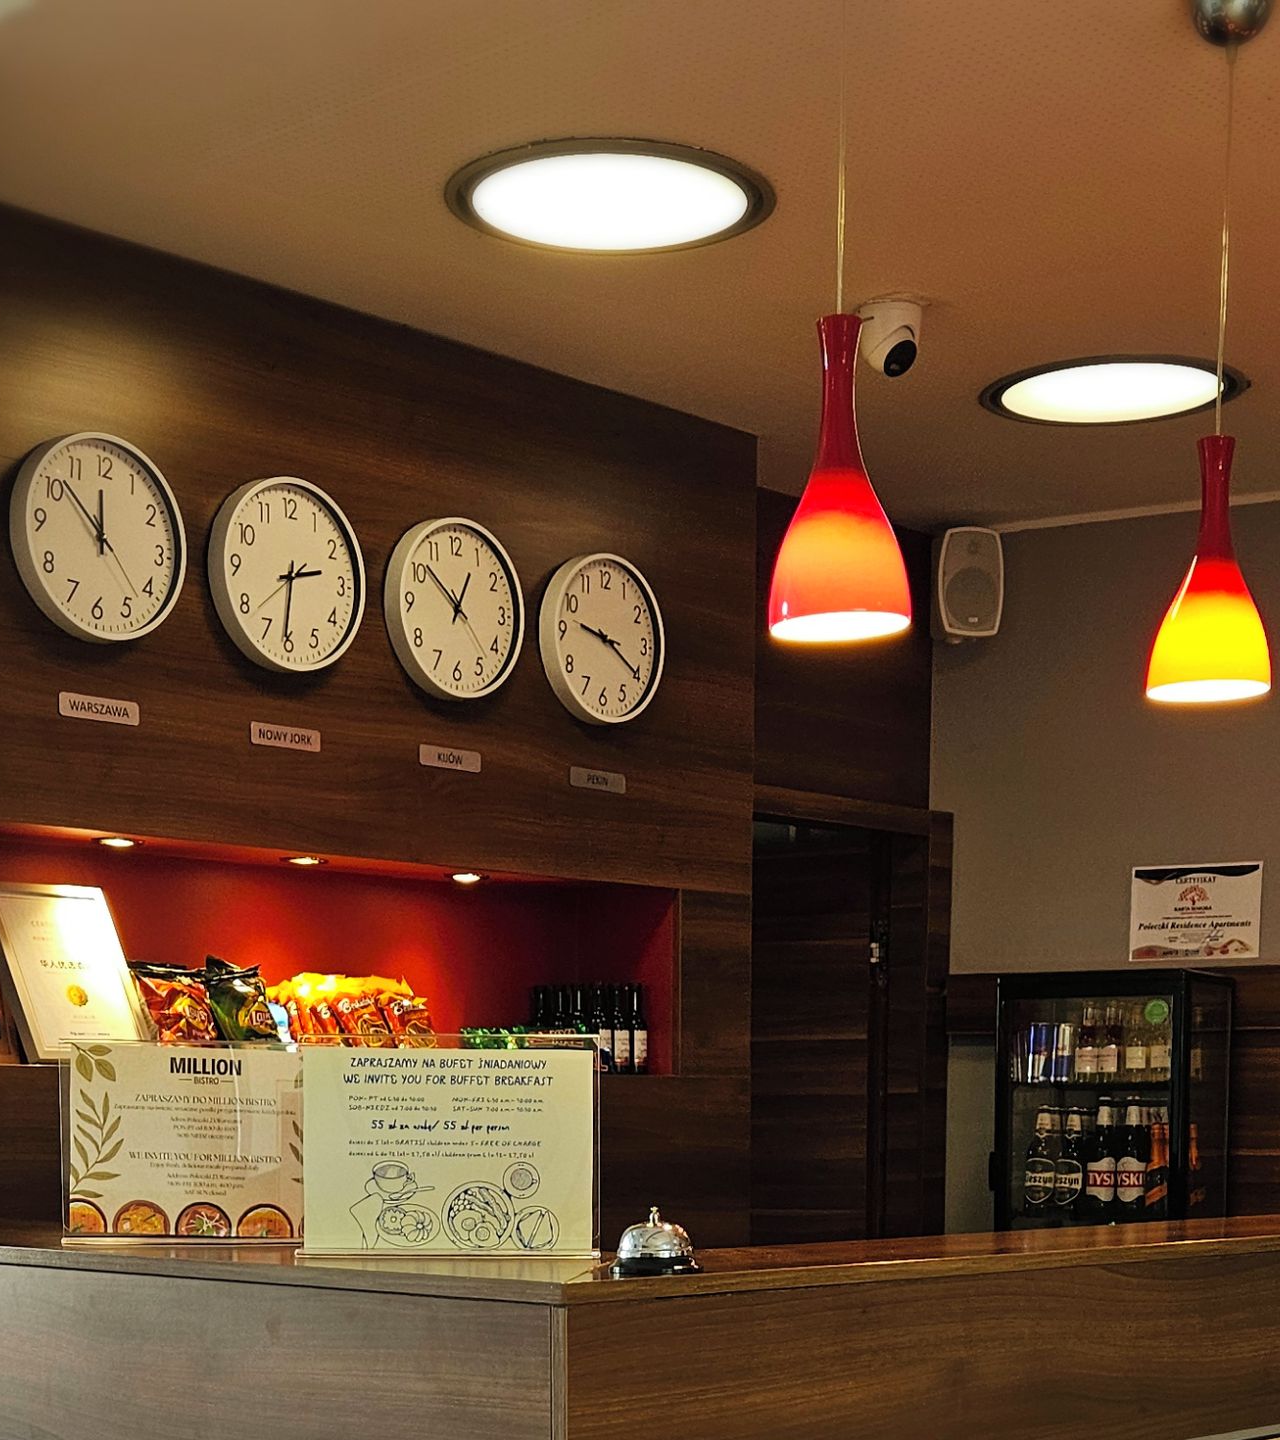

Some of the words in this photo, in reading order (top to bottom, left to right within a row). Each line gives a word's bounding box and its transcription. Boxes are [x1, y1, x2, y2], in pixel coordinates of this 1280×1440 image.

[68, 455, 81, 481] 11
[96, 454, 113, 481] 12
[44, 475, 63, 501] 10
[129, 473, 135, 495] 1
[145, 504, 157, 528] 2
[258, 501, 270, 524] 11
[282, 497, 298, 521] 12
[34, 508, 47, 532] 9
[311, 512, 317, 533] 1
[238, 522, 255, 546] 10
[154, 544, 164, 567] 3
[327, 539, 337, 560] 2
[428, 541, 439, 562] 11
[449, 535, 463, 557] 12
[43, 550, 55, 574] 8
[230, 553, 242, 577] 9
[475, 547, 479, 567] 1
[411, 561, 427, 584] 10
[489, 572, 498, 592] 2
[599, 569, 611, 590] 12
[67, 578, 80, 603] 7
[142, 576, 154, 598] 4
[336, 576, 345, 597] 3
[580, 573, 590, 594] 11
[621, 582, 626, 600] 1
[91, 596, 103, 620] 6
[120, 596, 133, 618] 5
[240, 592, 250, 614] 8
[404, 591, 415, 613] 9
[565, 593, 578, 614] 10
[327, 606, 337, 627] 4
[498, 606, 506, 626] 3
[634, 605, 641, 624] 2
[261, 616, 273, 640] 7
[309, 628, 319, 649] 5
[414, 627, 423, 647] 8
[558, 620, 567, 641] 9
[283, 630, 294, 653] 6
[490, 635, 499, 656] 4
[640, 638, 648, 656] 3
[432, 649, 443, 671] 7
[474, 657, 483, 676] 5
[565, 654, 574, 673] 8
[452, 660, 462, 682] 6
[632, 665, 640, 682] 4
[581, 675, 591, 696] 7
[618, 683, 627, 702] 5
[598, 687, 608, 707] 6
[68, 698, 130, 718] WARSZAWA
[258, 728, 288, 742] NOWY
[290, 733, 312, 746] JORK
[438, 752, 463, 764] KIJÓW
[1171, 921, 1206, 930] Residence
[1208, 920, 1252, 930] Apartments
[170, 1056, 242, 1076] MILLION
[351, 1058, 418, 1068] ZAPRASZAMY
[422, 1058, 436, 1068] NA
[440, 1058, 473, 1069] BUFET
[478, 1058, 547, 1070] ŚNIADANIOWY
[193, 1076, 220, 1085] BISTRO
[343, 1074, 360, 1084] WE
[364, 1074, 398, 1084] INVITE
[402, 1074, 422, 1084] YOU
[425, 1074, 446, 1085] FOR
[450, 1075, 490, 1086] BUFFET
[494, 1076, 554, 1086] BREAKFAST
[135, 1094, 191, 1104] ZAPRASZAMY
[193, 1095, 208, 1104] DO
[370, 1119, 385, 1130] 55
[443, 1120, 457, 1130] 55
[471, 1124, 483, 1134] per
[486, 1124, 510, 1134] person
[128, 1151, 142, 1160] WE
[144, 1152, 172, 1160] INVITE
[174, 1152, 194, 1161] YOU
[194, 1153, 212, 1162] FOR
[213, 1154, 250, 1163] MILLION
